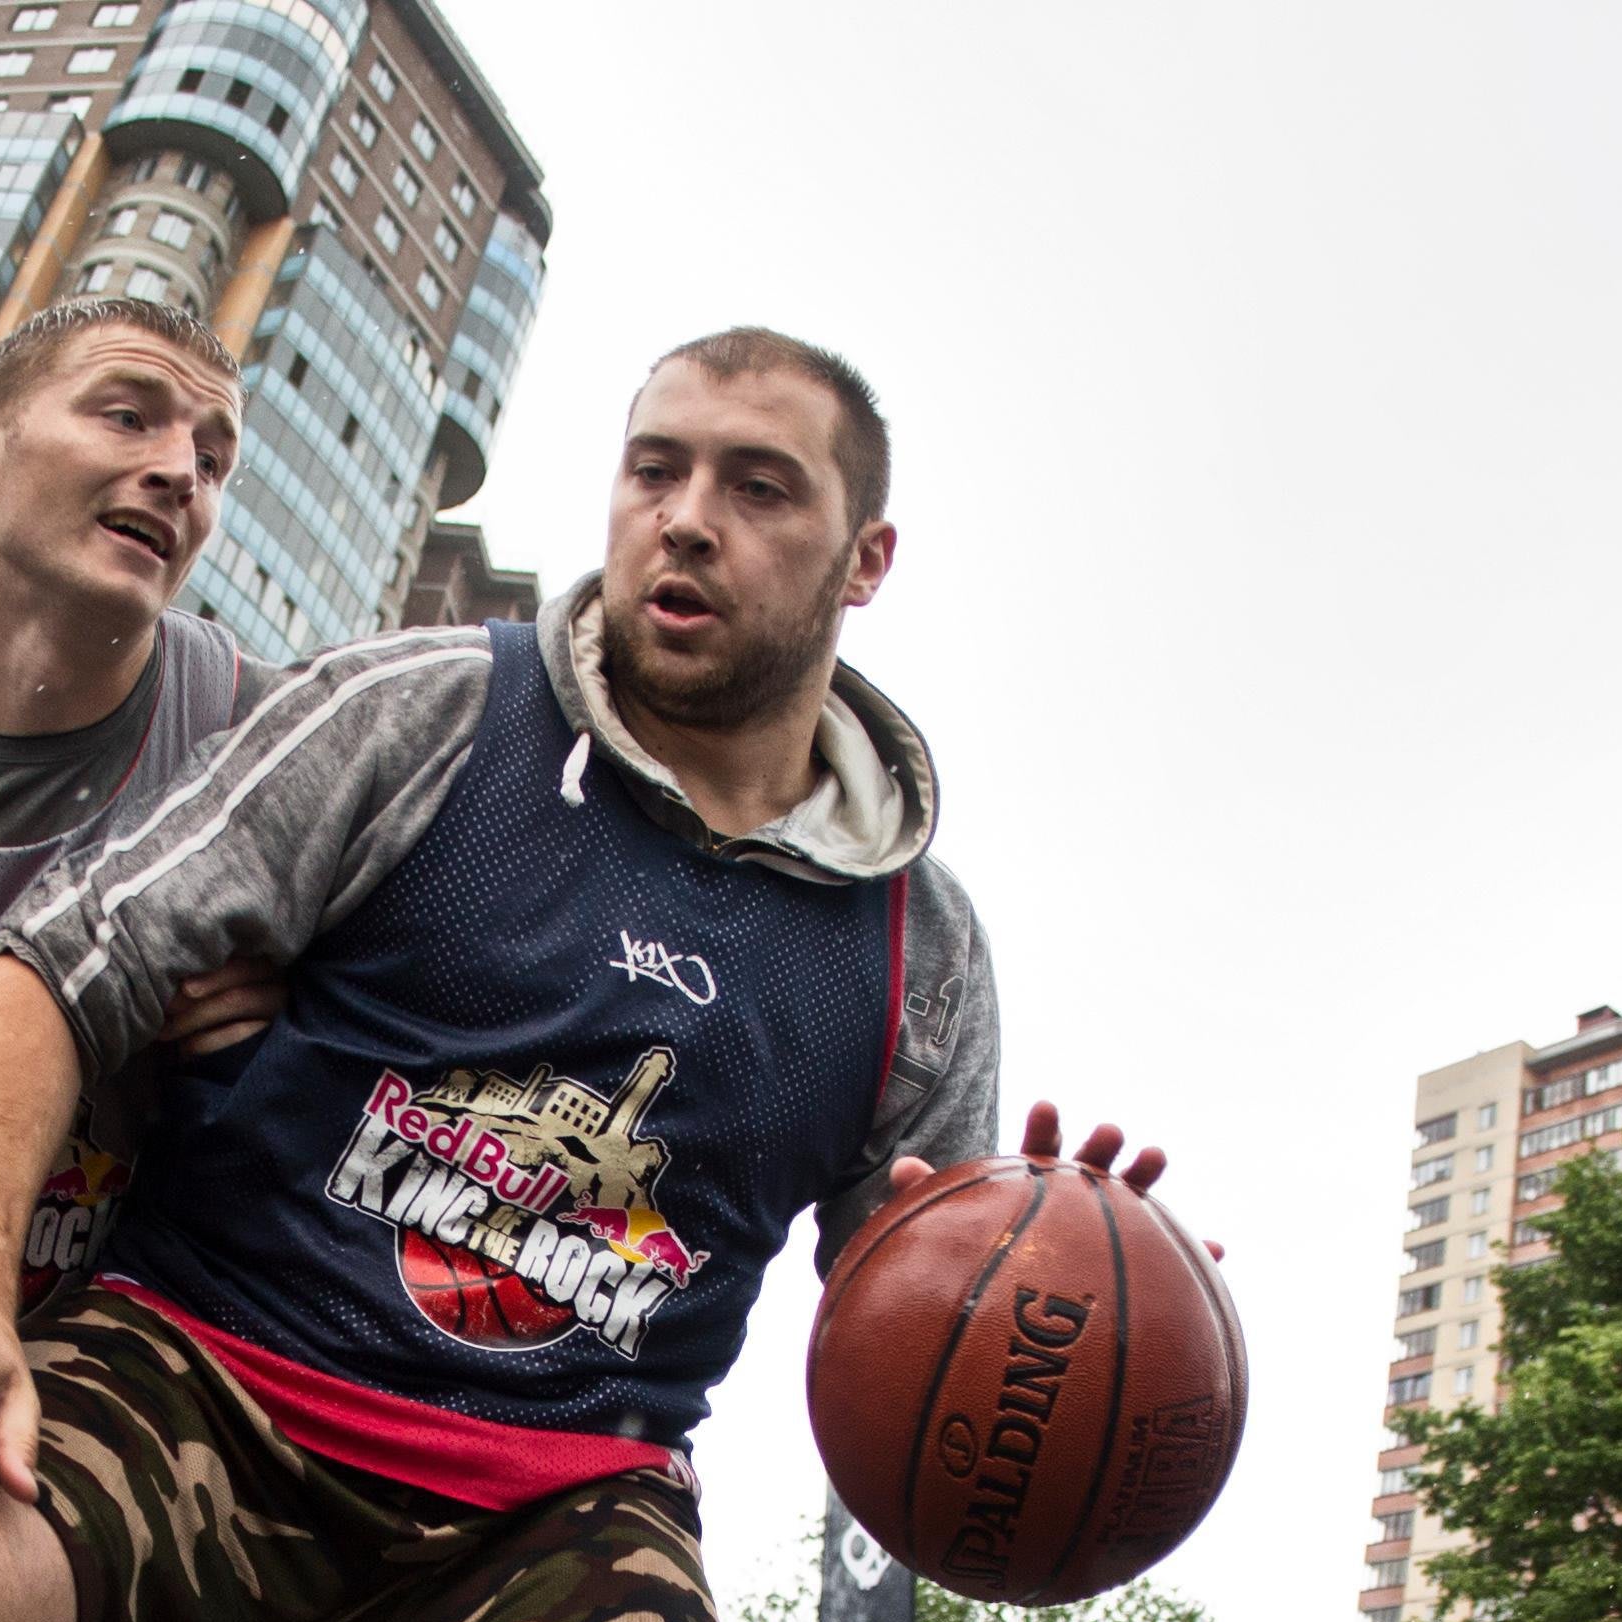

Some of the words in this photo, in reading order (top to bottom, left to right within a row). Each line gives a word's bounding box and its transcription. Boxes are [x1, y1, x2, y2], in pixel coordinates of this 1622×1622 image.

[330, 1114, 487, 1246] KING
[367, 1071, 473, 1160] Red
[465, 1133, 568, 1211] Bull
[26, 1197, 121, 1270] OCK
[467, 1225, 522, 1266] THE
[486, 1205, 525, 1235] OF
[515, 1220, 670, 1355] ROCK
[943, 1284, 1095, 1588] SPALDING
